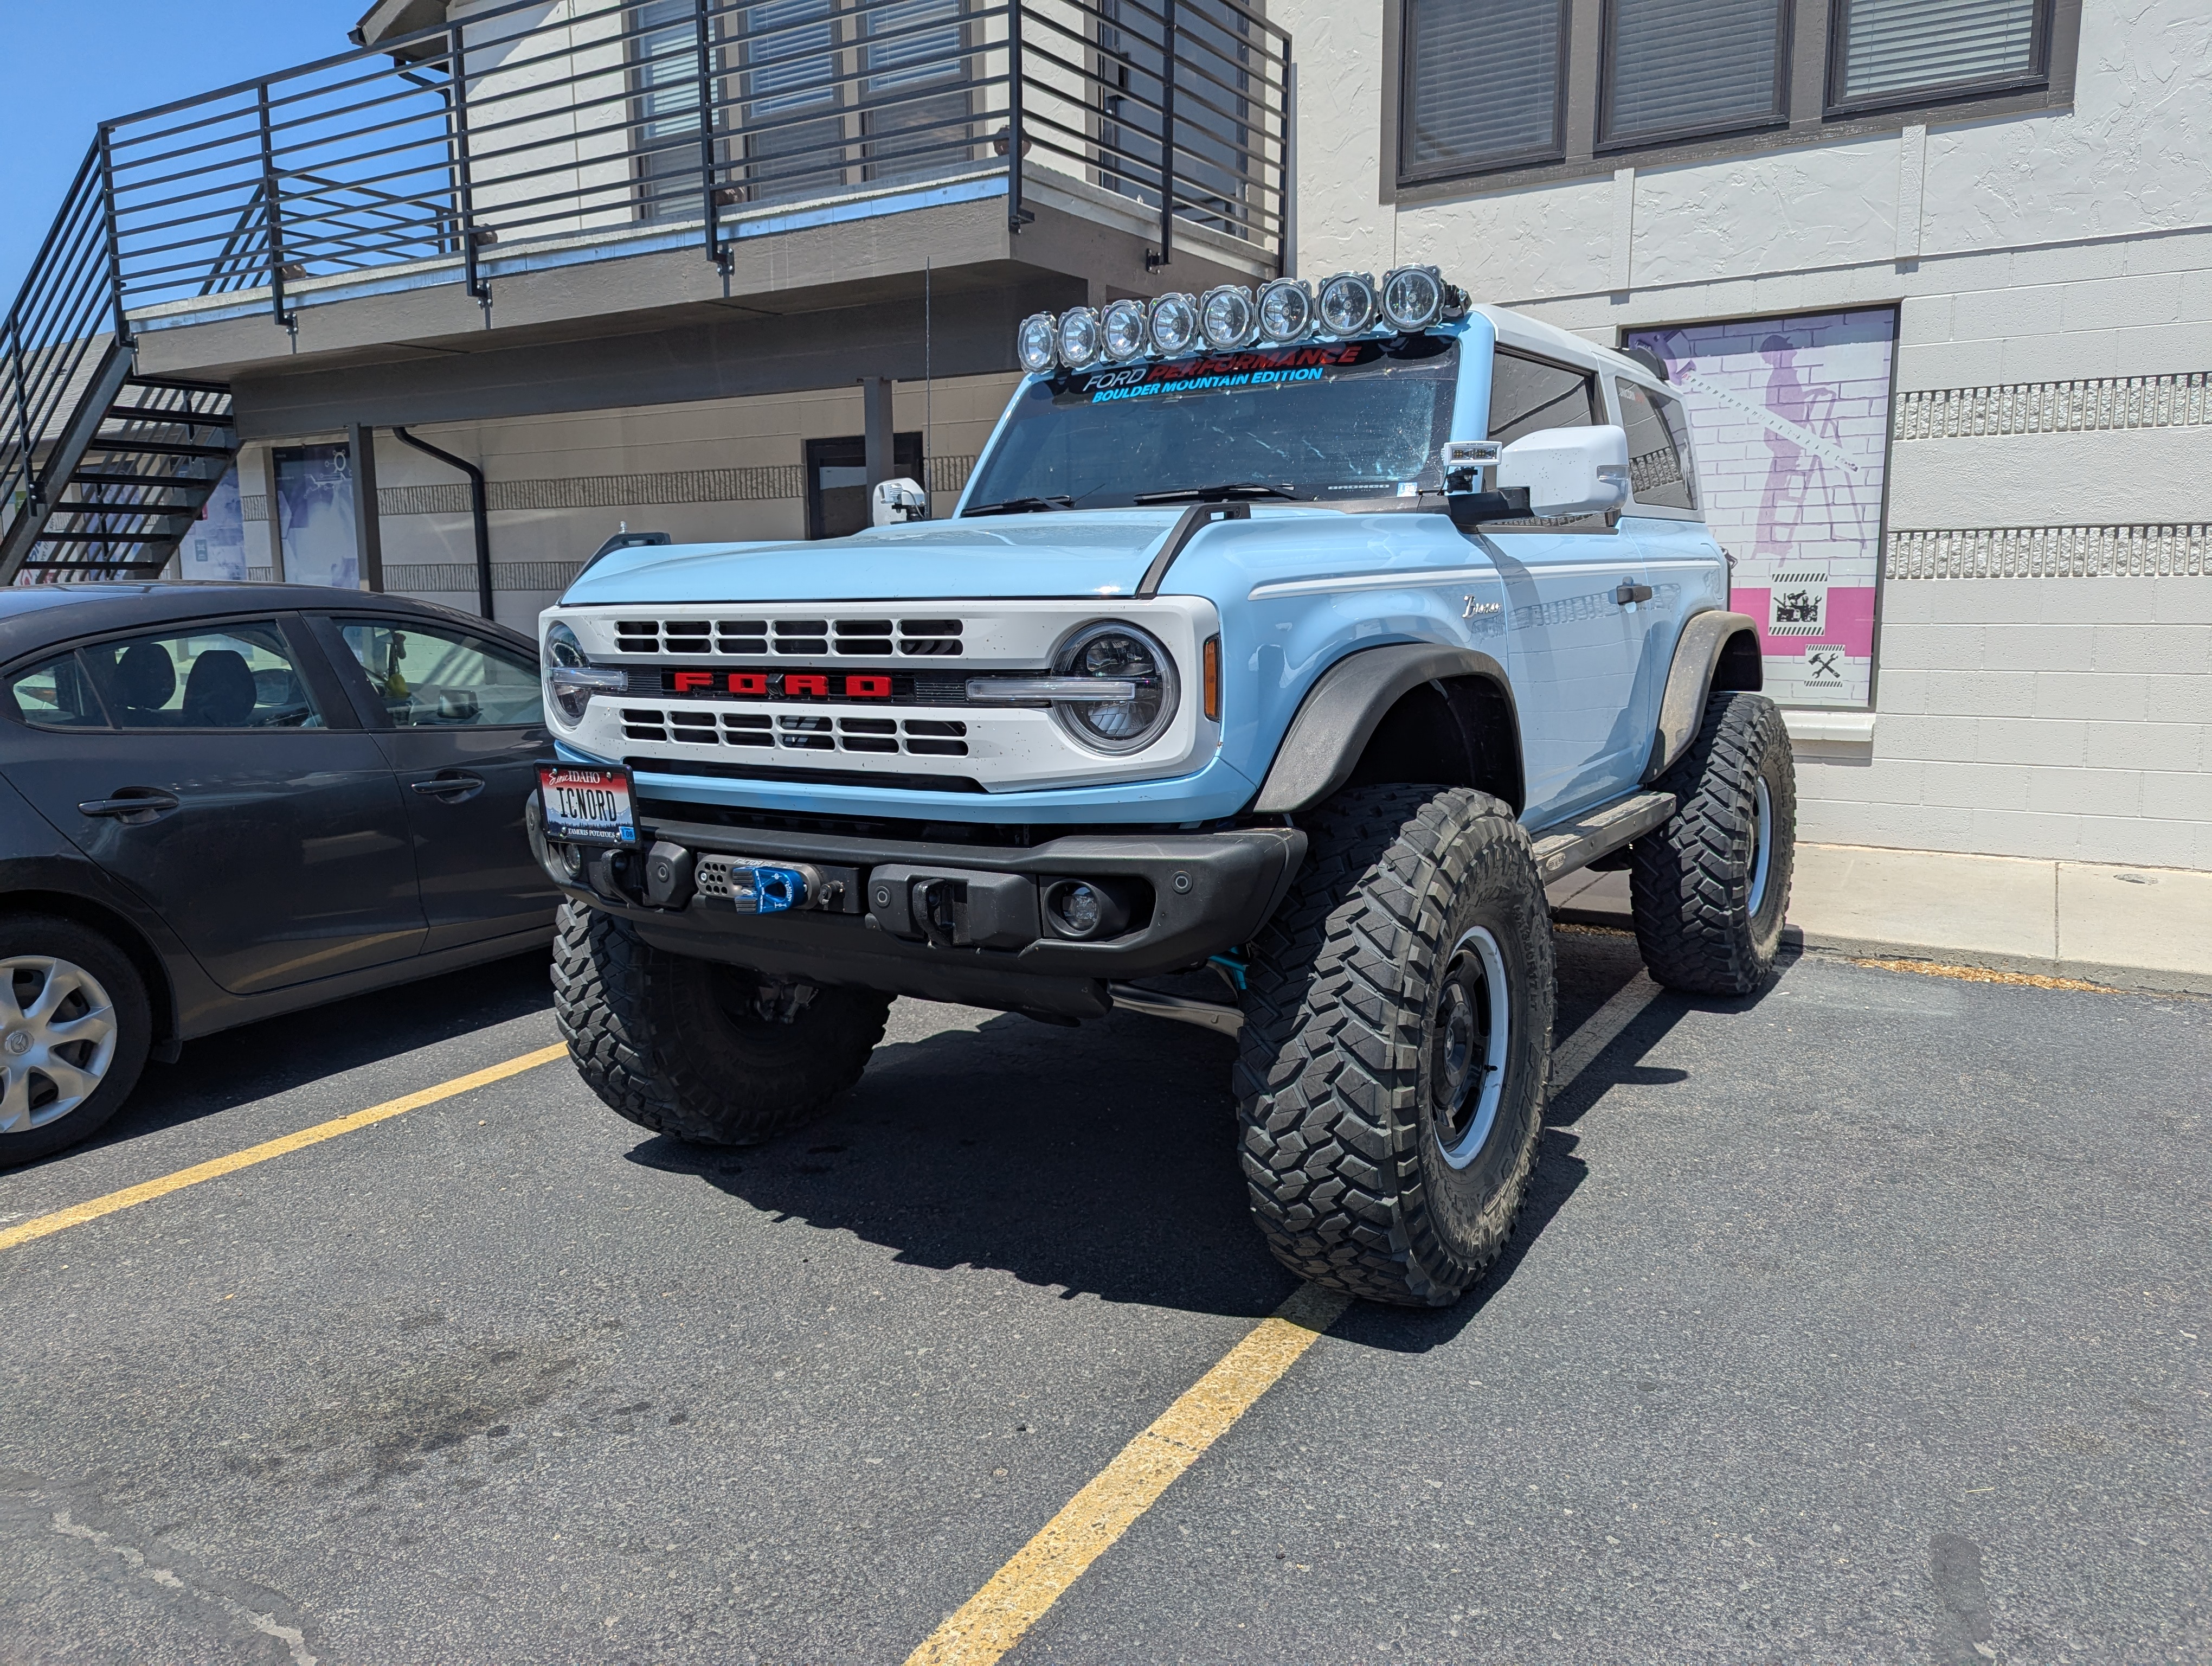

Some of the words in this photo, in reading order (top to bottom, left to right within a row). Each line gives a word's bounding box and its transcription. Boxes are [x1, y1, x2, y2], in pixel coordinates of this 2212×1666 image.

[1083, 368, 1147, 392] FORD
[1147, 347, 1362, 381] PERFORMANCE
[1092, 383, 1161, 403] BOULDER
[1161, 374, 1249, 392] MOUNTAIN
[1251, 368, 1323, 383] EDITION
[1462, 594, 1502, 618] Bronco
[675, 672, 893, 697] FORD
[549, 772, 570, 785] Scenic
[568, 771, 600, 784] IDAHO
[556, 787, 617, 822] ICNORD
[589, 830, 615, 838] POTATOES
